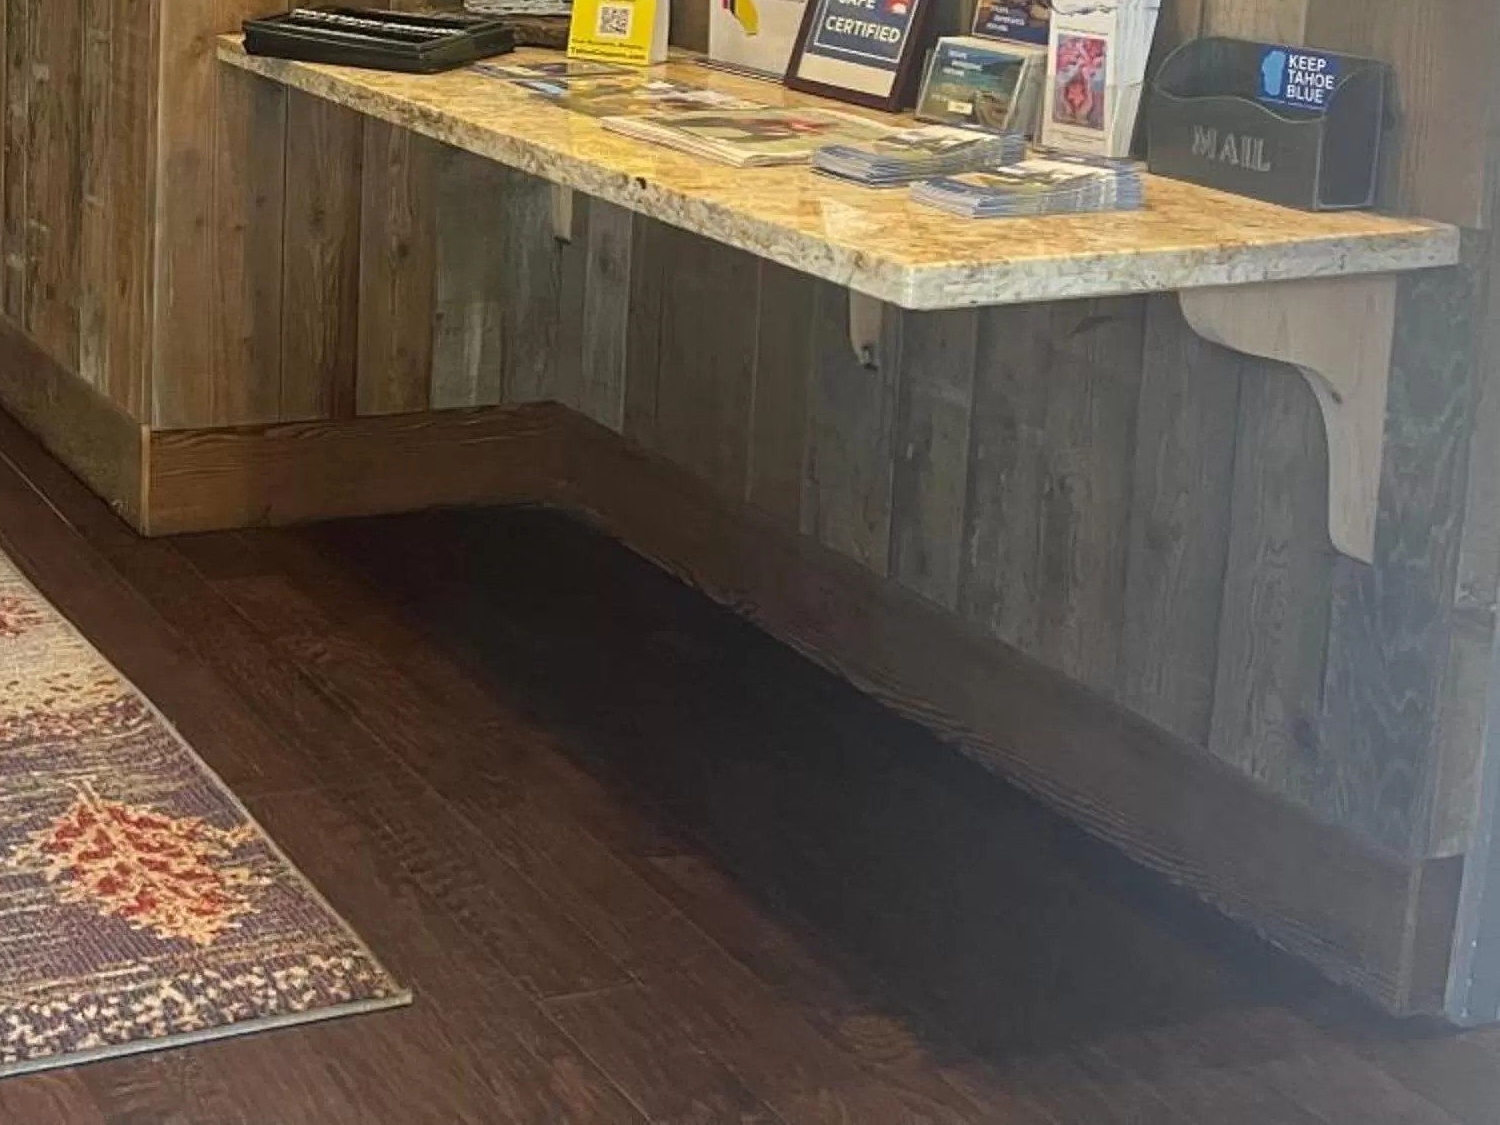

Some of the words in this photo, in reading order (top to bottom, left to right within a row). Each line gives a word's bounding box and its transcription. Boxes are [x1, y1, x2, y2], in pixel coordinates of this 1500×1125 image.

[825, 15, 901, 43] CERTIFIED
[1288, 54, 1326, 72] KEEP
[1288, 69, 1335, 90] TAHOE
[1285, 84, 1325, 104] BLUE
[1191, 125, 1270, 172] MAIL
